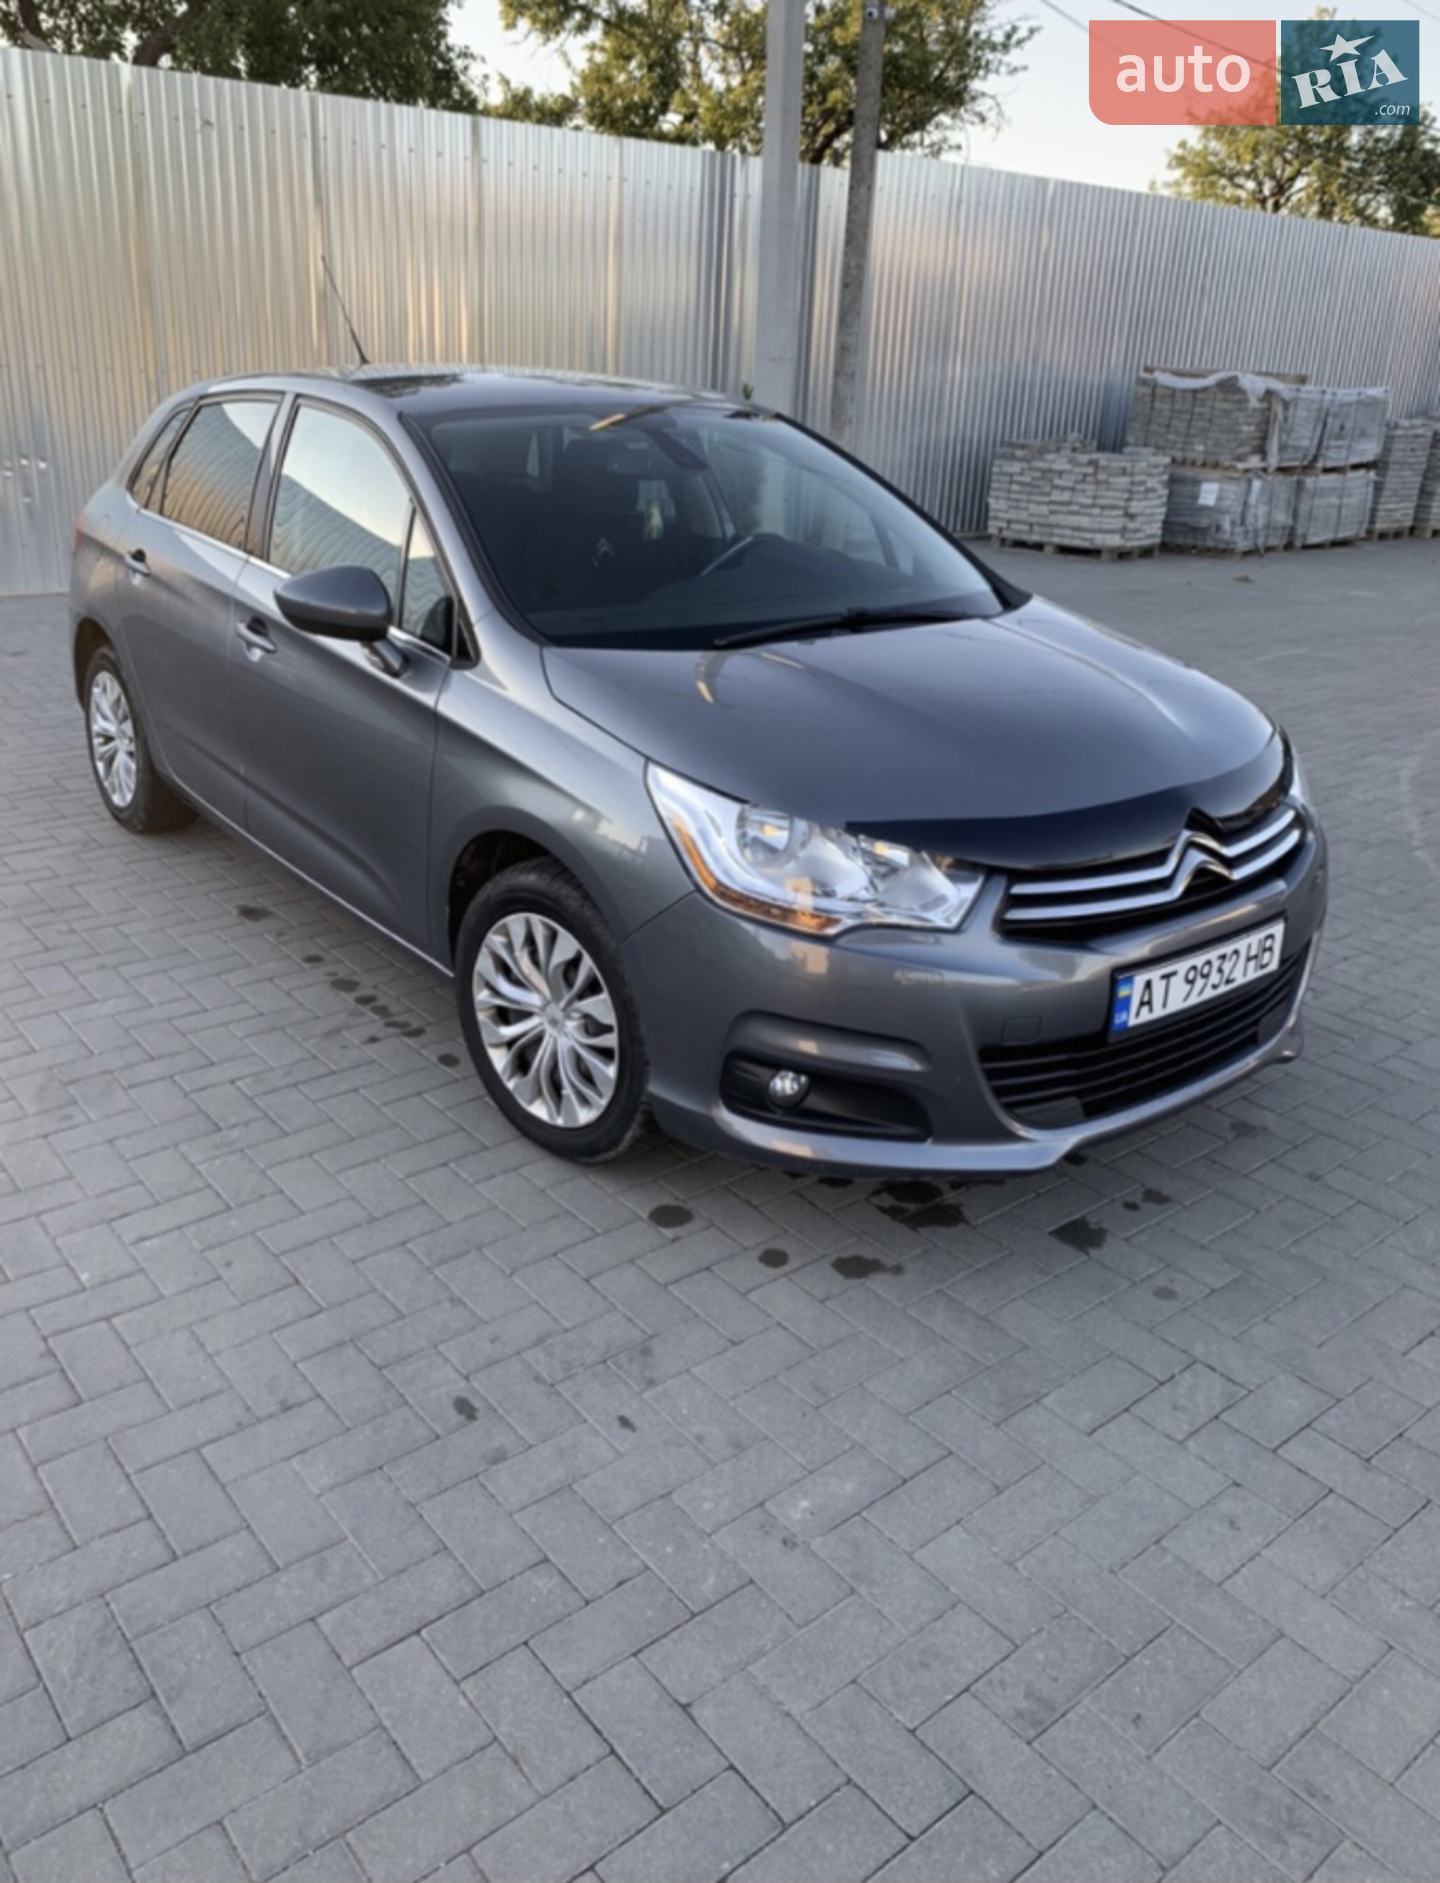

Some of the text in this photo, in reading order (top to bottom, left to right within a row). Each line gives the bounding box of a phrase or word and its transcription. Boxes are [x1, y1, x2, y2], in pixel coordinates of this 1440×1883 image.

[1135, 933, 1276, 1019] AT 9932 HB
